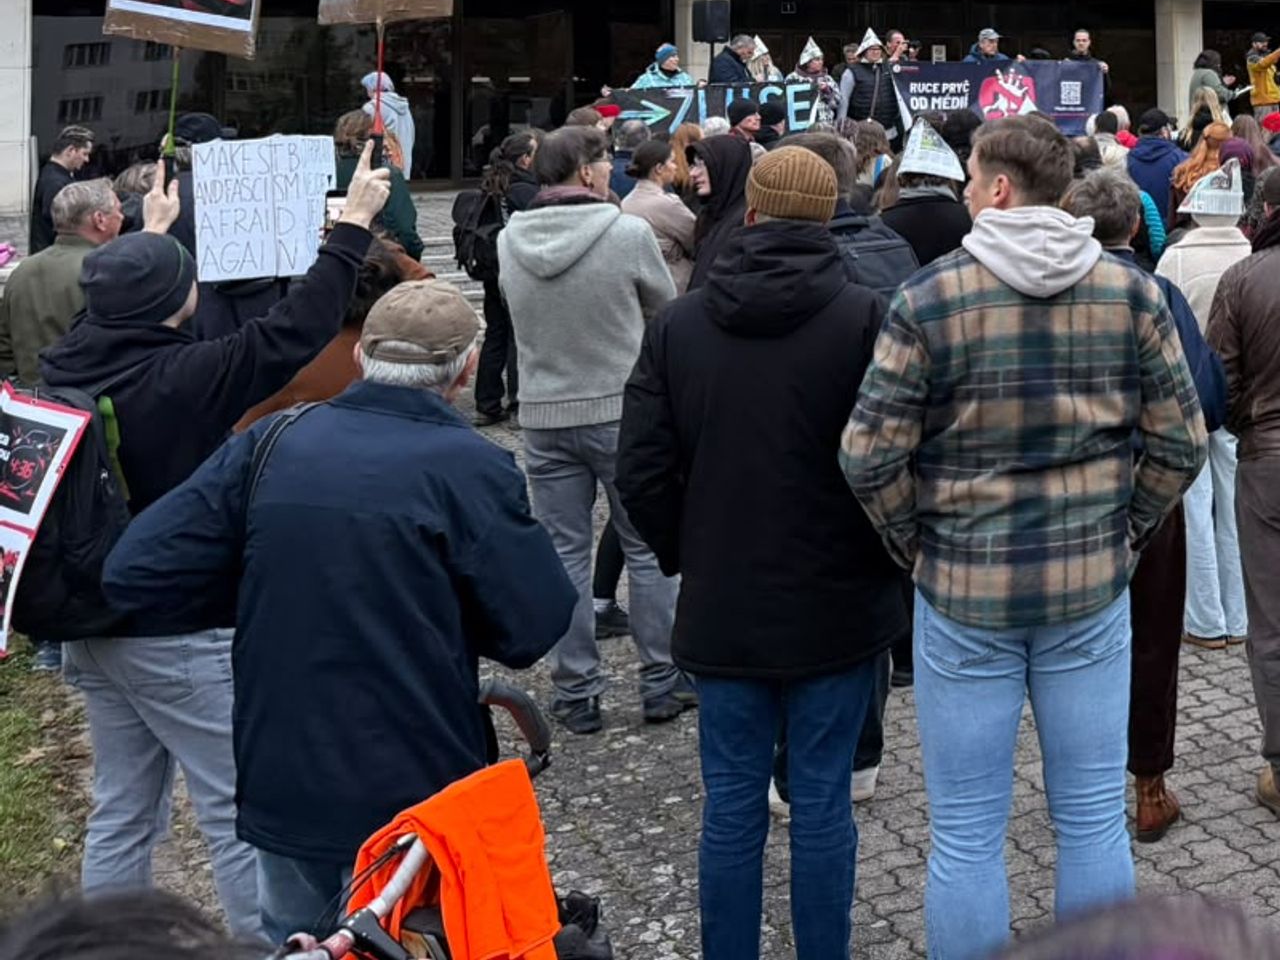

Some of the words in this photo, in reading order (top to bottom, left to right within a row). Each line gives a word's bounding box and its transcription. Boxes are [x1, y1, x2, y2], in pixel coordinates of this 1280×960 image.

[910, 82, 940, 94] RUCE
[942, 80, 970, 94] PRYČ
[910, 96, 929, 111] OD
[931, 93, 969, 111] MÉDIÍ
[194, 143, 254, 178] MAKE
[199, 206, 297, 240] AFRAID
[199, 239, 298, 276] AGAIN
